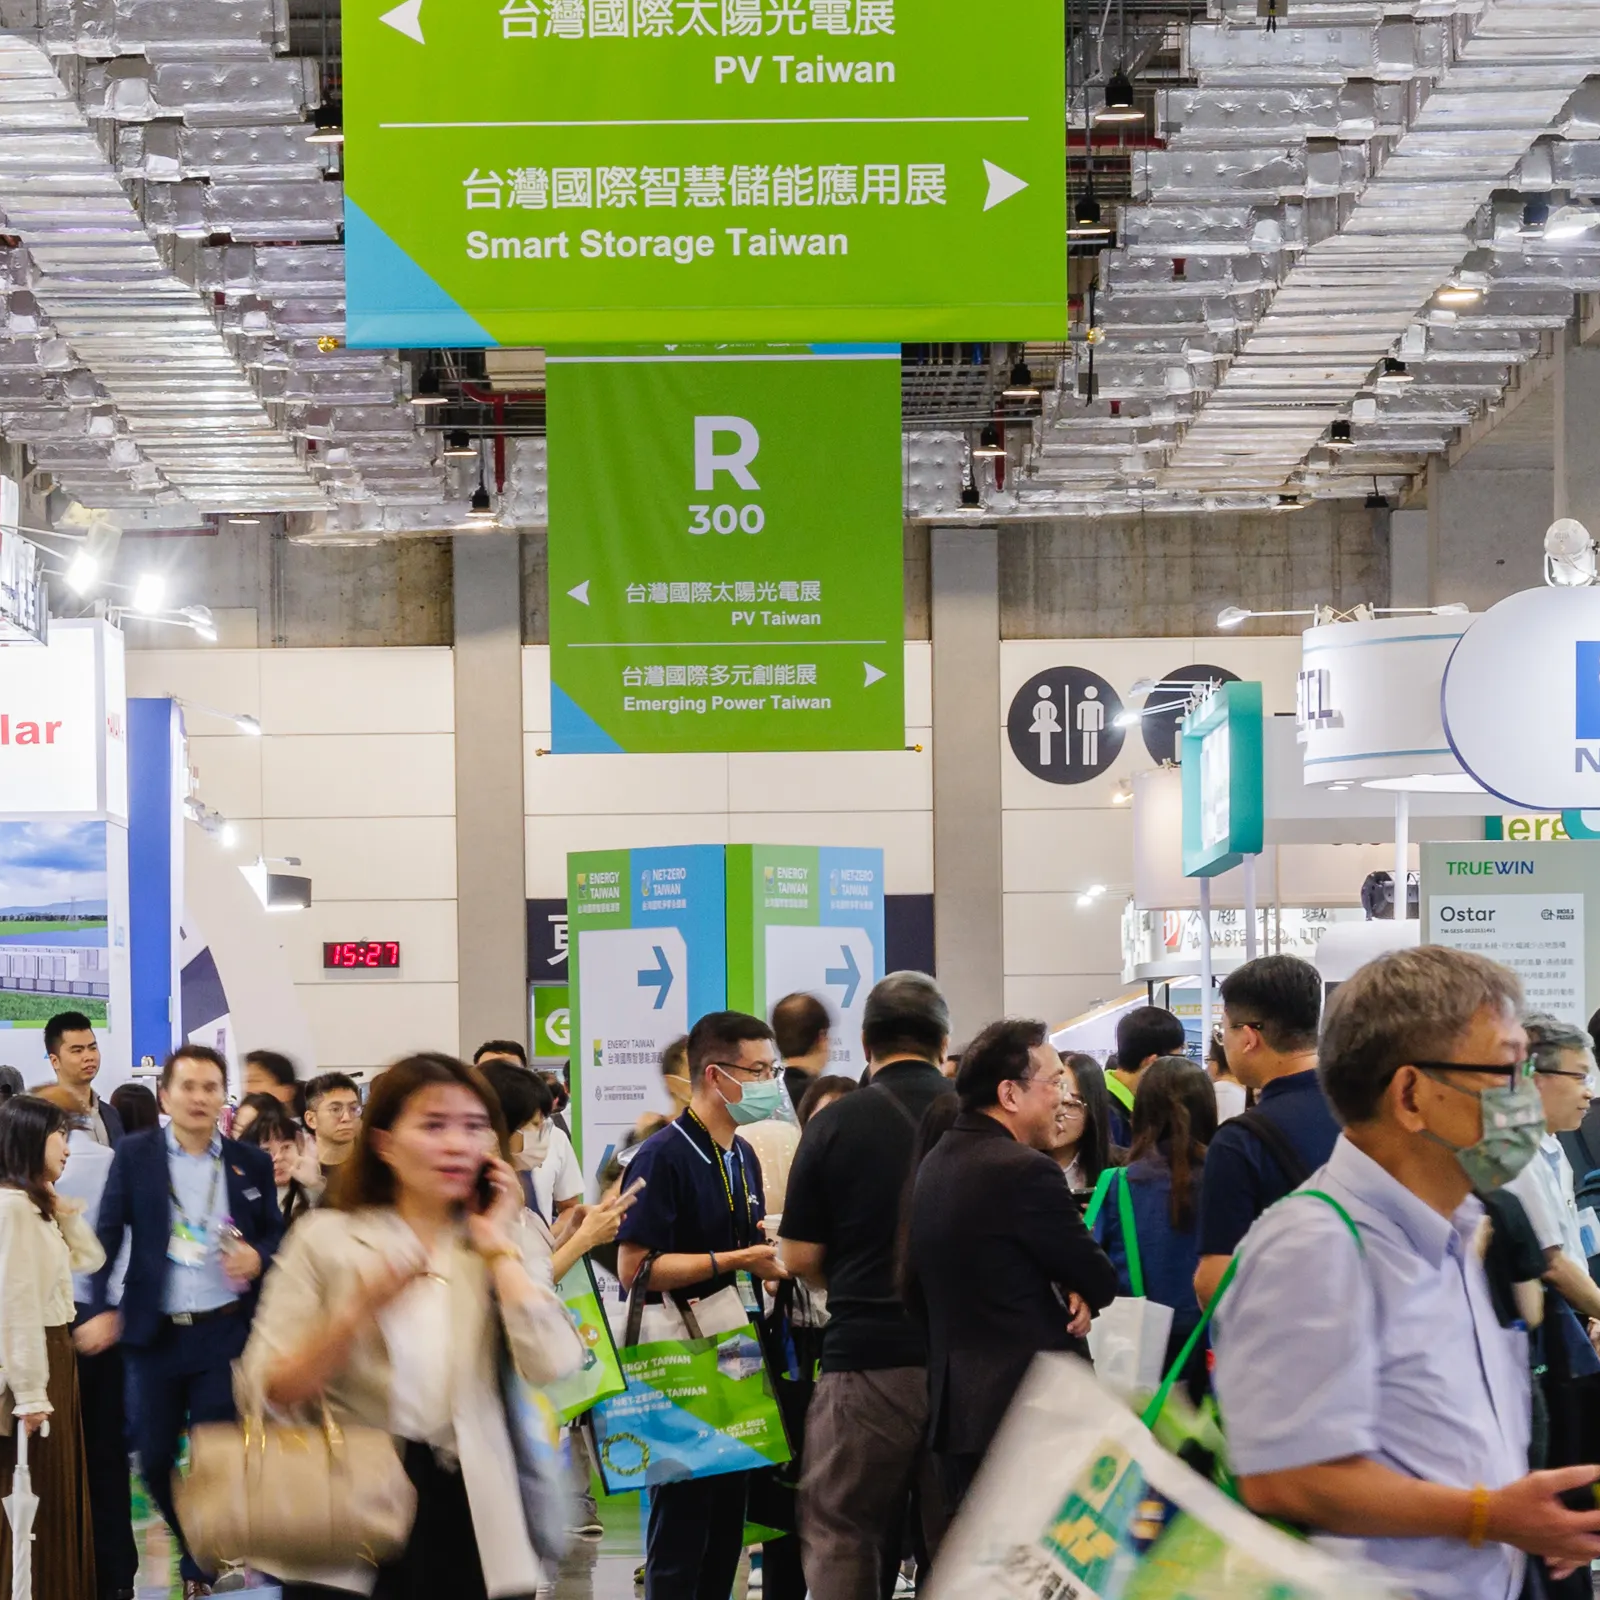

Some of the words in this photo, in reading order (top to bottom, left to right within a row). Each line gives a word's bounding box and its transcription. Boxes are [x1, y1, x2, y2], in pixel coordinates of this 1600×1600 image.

[715, 56, 763, 84] PV
[772, 55, 896, 84] Taiwan
[462, 164, 948, 210] 台灣國際智慧儲能應用展
[466, 231, 569, 260] Smart
[579, 229, 715, 264] Storage
[725, 228, 849, 257] Taiwan
[693, 415, 761, 491] R
[687, 504, 765, 535] 300
[625, 580, 822, 604] 台灣國際太陽光電展
[731, 612, 755, 625] PV
[760, 611, 822, 625] Taiwan
[621, 664, 818, 687] 台灣國際多元創能展
[623, 696, 706, 713] Emerging
[711, 696, 766, 710] Power
[770, 695, 832, 709] Taiwan
[652, 867, 686, 880] NET-ZERO
[777, 867, 808, 879] ENERGY
[1446, 861, 1534, 876] TRUEWIN
[589, 871, 620, 885] ENERGY
[589, 886, 620, 899] TAIWAN
[653, 883, 681, 896] TAIWAN
[777, 882, 808, 895] TAIWAN
[841, 884, 869, 896] TAIWAN
[1440, 906, 1496, 922] Ostar
[332, 943, 399, 967] 15:27
[607, 1040, 631, 1050] ENERGY
[631, 1039, 655, 1048] TAIWAN
[651, 1355, 691, 1367] TAIWAN
[667, 1386, 708, 1398] TAIWAN
